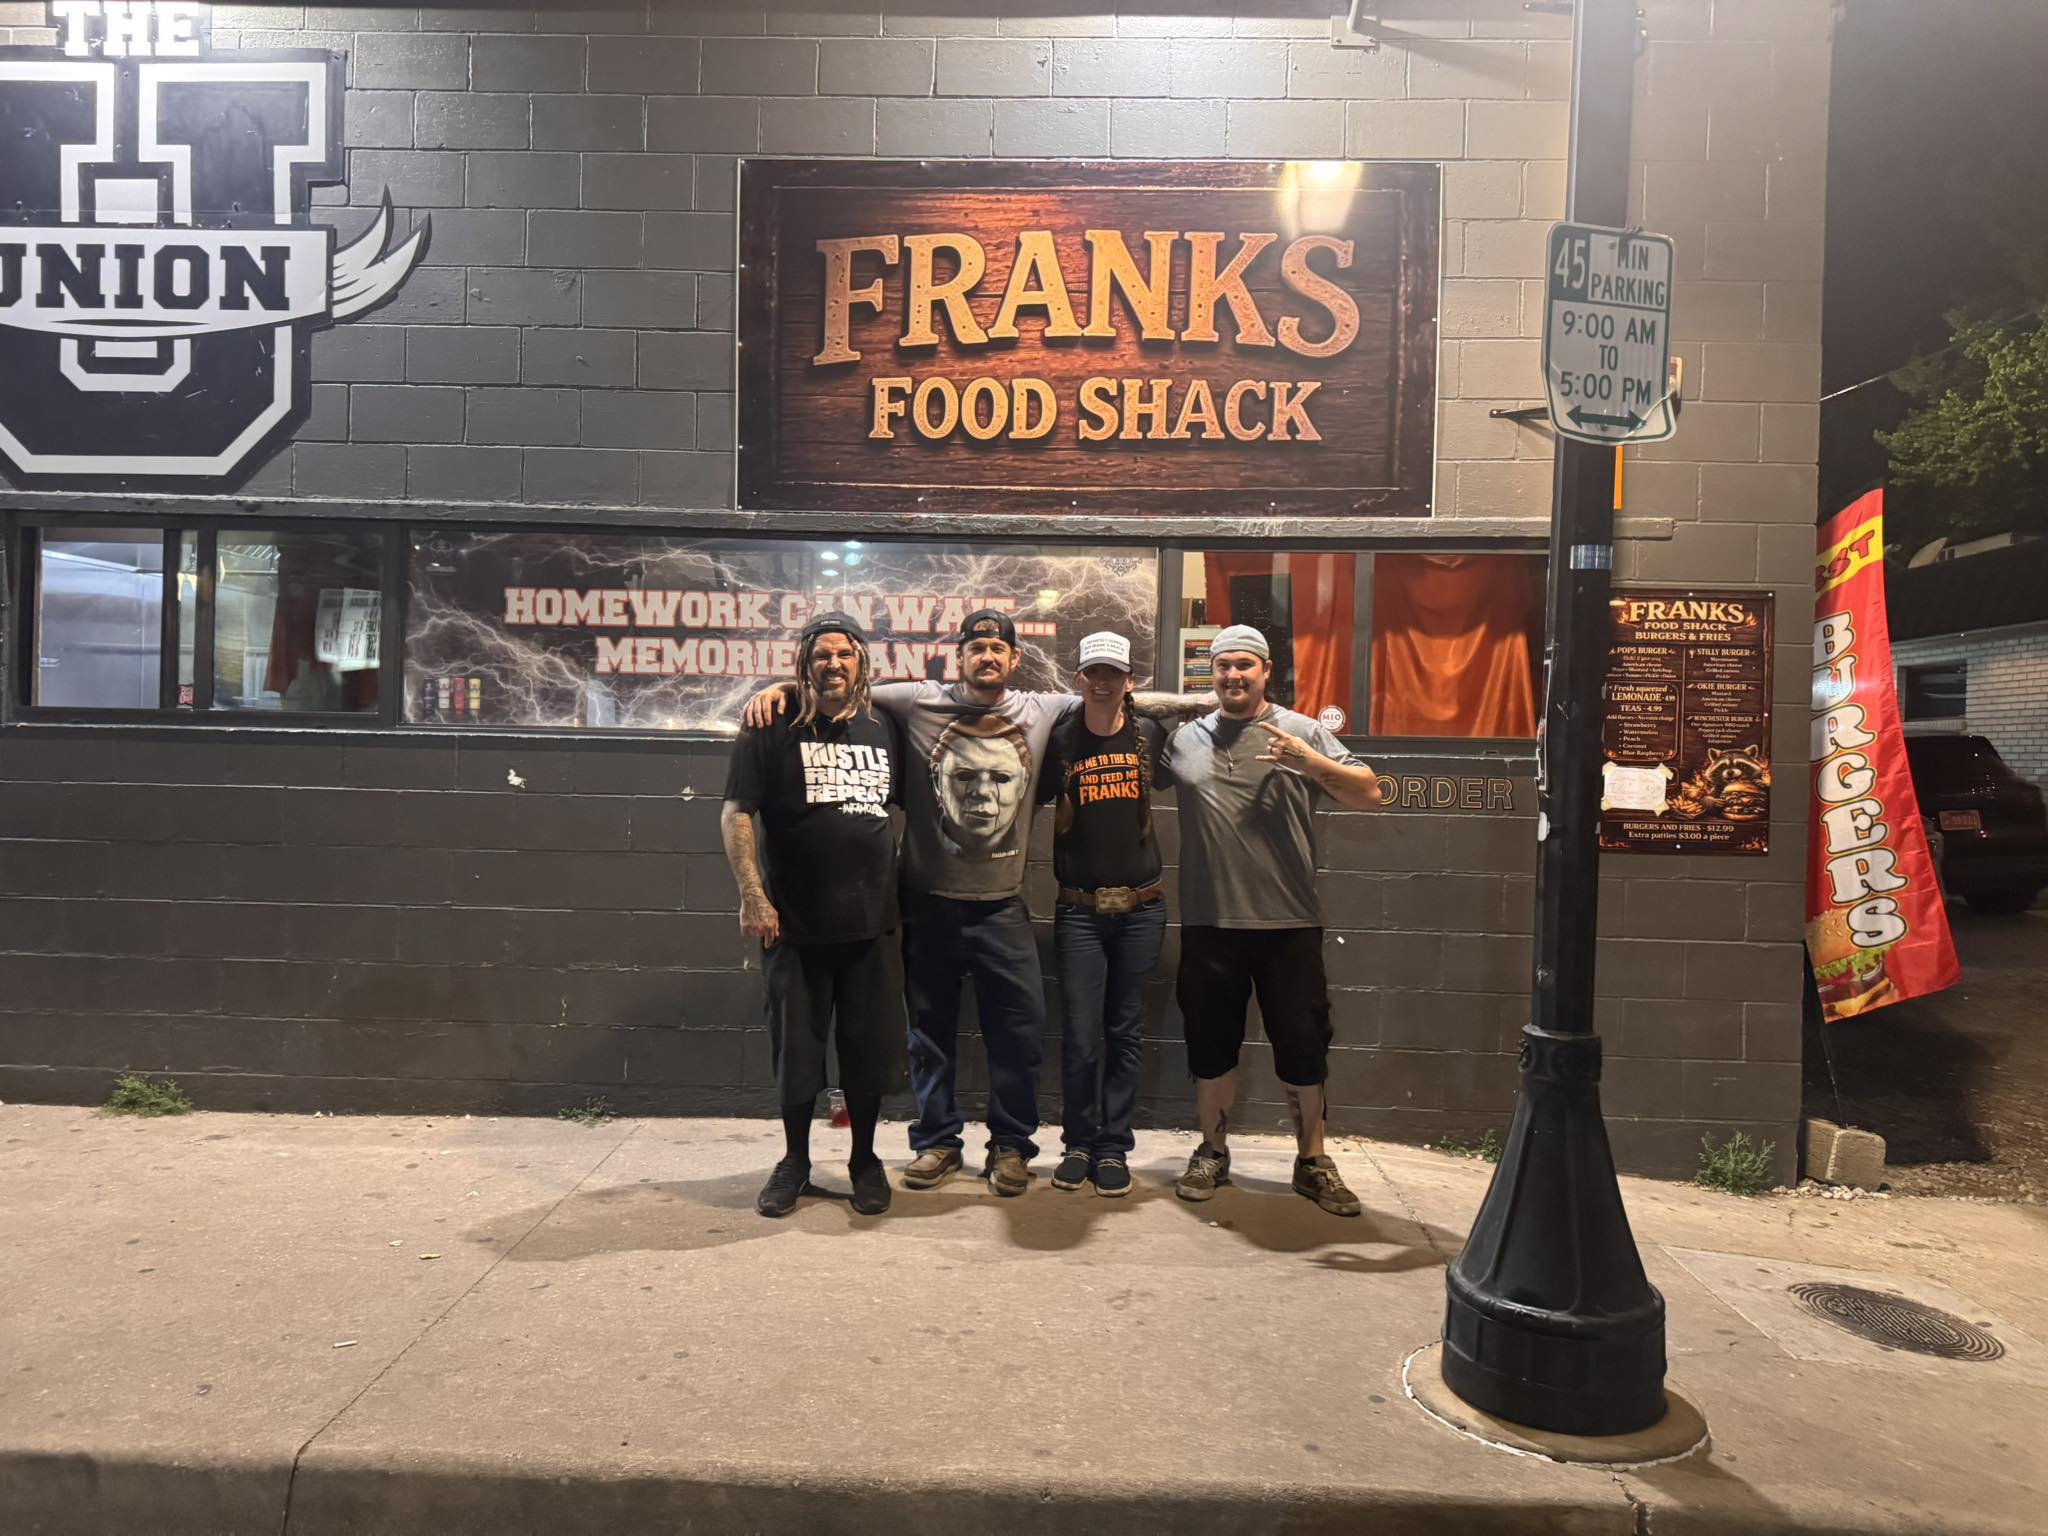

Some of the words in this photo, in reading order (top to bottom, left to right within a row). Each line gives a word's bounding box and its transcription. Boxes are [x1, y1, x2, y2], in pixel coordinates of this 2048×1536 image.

[53, 1, 200, 56] THE
[1554, 238, 1586, 290] 45
[1617, 244, 1649, 271] MIN
[813, 230, 1360, 366] FRANKS
[1590, 273, 1665, 307] PARKING
[1562, 310, 1615, 339] 9:00
[1624, 316, 1656, 345] AM
[1599, 344, 1618, 371] TO
[1560, 371, 1612, 400] 5:00
[1622, 376, 1652, 406] PM
[868, 376, 1058, 440] FOOD
[1078, 378, 1322, 442] SHACK
[504, 587, 773, 629] HOMEWORK
[1629, 600, 1745, 624] FRANKS
[1635, 632, 1686, 641] BURGERS
[1688, 632, 1697, 641] &
[1699, 633, 1732, 641] FRIES
[1644, 622, 1679, 630] FOOD
[1683, 622, 1728, 631] SHACK
[595, 636, 801, 677] MEMORIE
[868, 640, 960, 680] AN'T
[1617, 646, 1637, 654] POPS
[1638, 646, 1668, 655] BURGER
[1697, 648, 1720, 656] STILLY
[1721, 648, 1751, 656] BURGER
[1612, 692, 1662, 701] LEMONADE
[1635, 685, 1668, 693] squeezed
[800, 742, 890, 773] HUSTLE
[1085, 756, 1098, 769] ME
[1098, 754, 1109, 765] TO
[1109, 753, 1126, 764] THE
[803, 767, 891, 790] RINSE
[1080, 774, 1099, 785] AND
[1101, 772, 1123, 783] FEED
[1126, 769, 1139, 780] ME
[1810, 609, 1909, 952] BURGERS
[806, 783, 890, 806] REPEAT
[1079, 780, 1140, 806] FRANKS
[1375, 775, 1514, 811] ORDER
[1623, 822, 1660, 830] BURGERS
[1660, 823, 1678, 831] AND
[1679, 824, 1702, 832] FRIES
[1707, 825, 1735, 833] $12.99
[1651, 832, 1677, 840] patties
[1678, 832, 1702, 840] $3.00
[1709, 834, 1730, 842] piece
